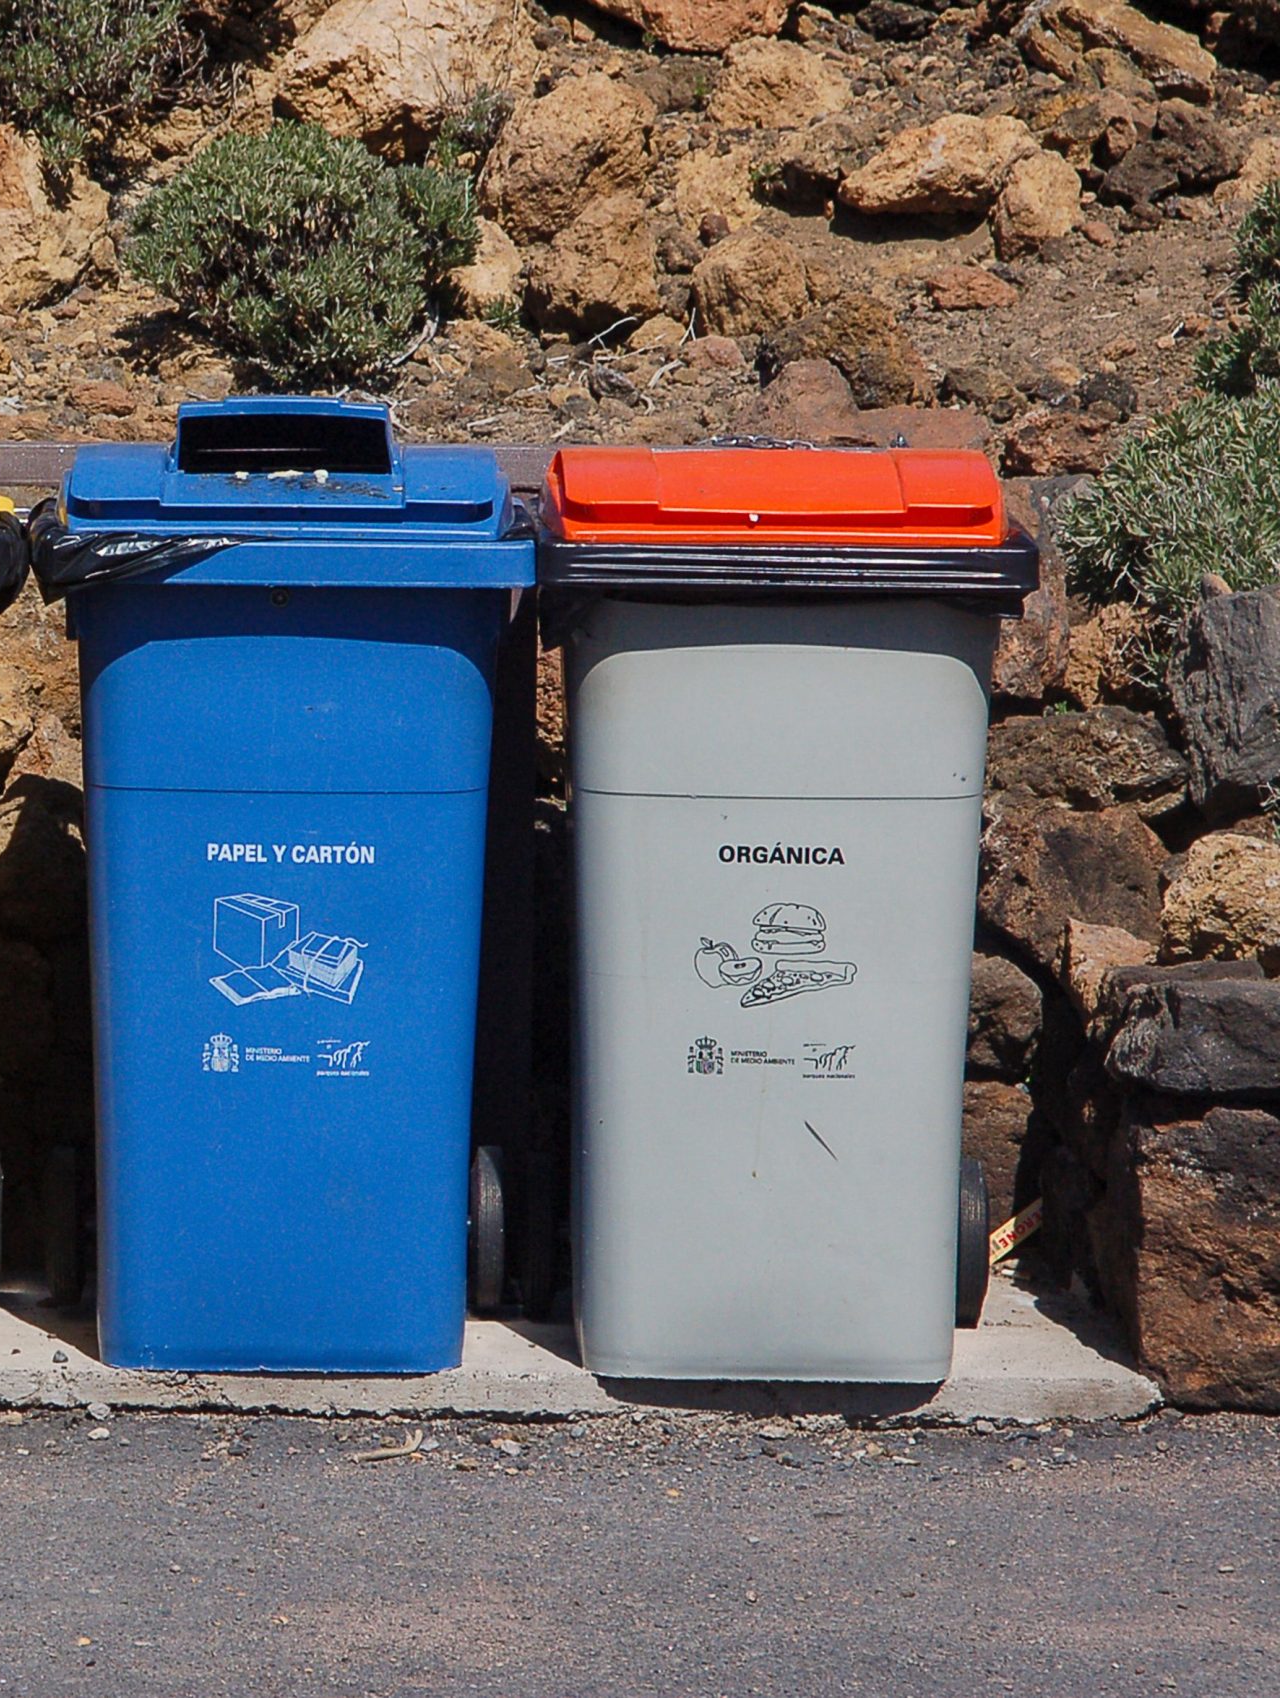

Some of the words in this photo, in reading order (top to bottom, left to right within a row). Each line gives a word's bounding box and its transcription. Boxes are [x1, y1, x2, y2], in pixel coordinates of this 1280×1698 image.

[207, 843, 267, 863] PAPEL
[272, 845, 286, 863] Y
[291, 841, 375, 864] CARTÓN
[718, 841, 845, 865] ORGÁNICA
[277, 1055, 310, 1063] AMBIENTE
